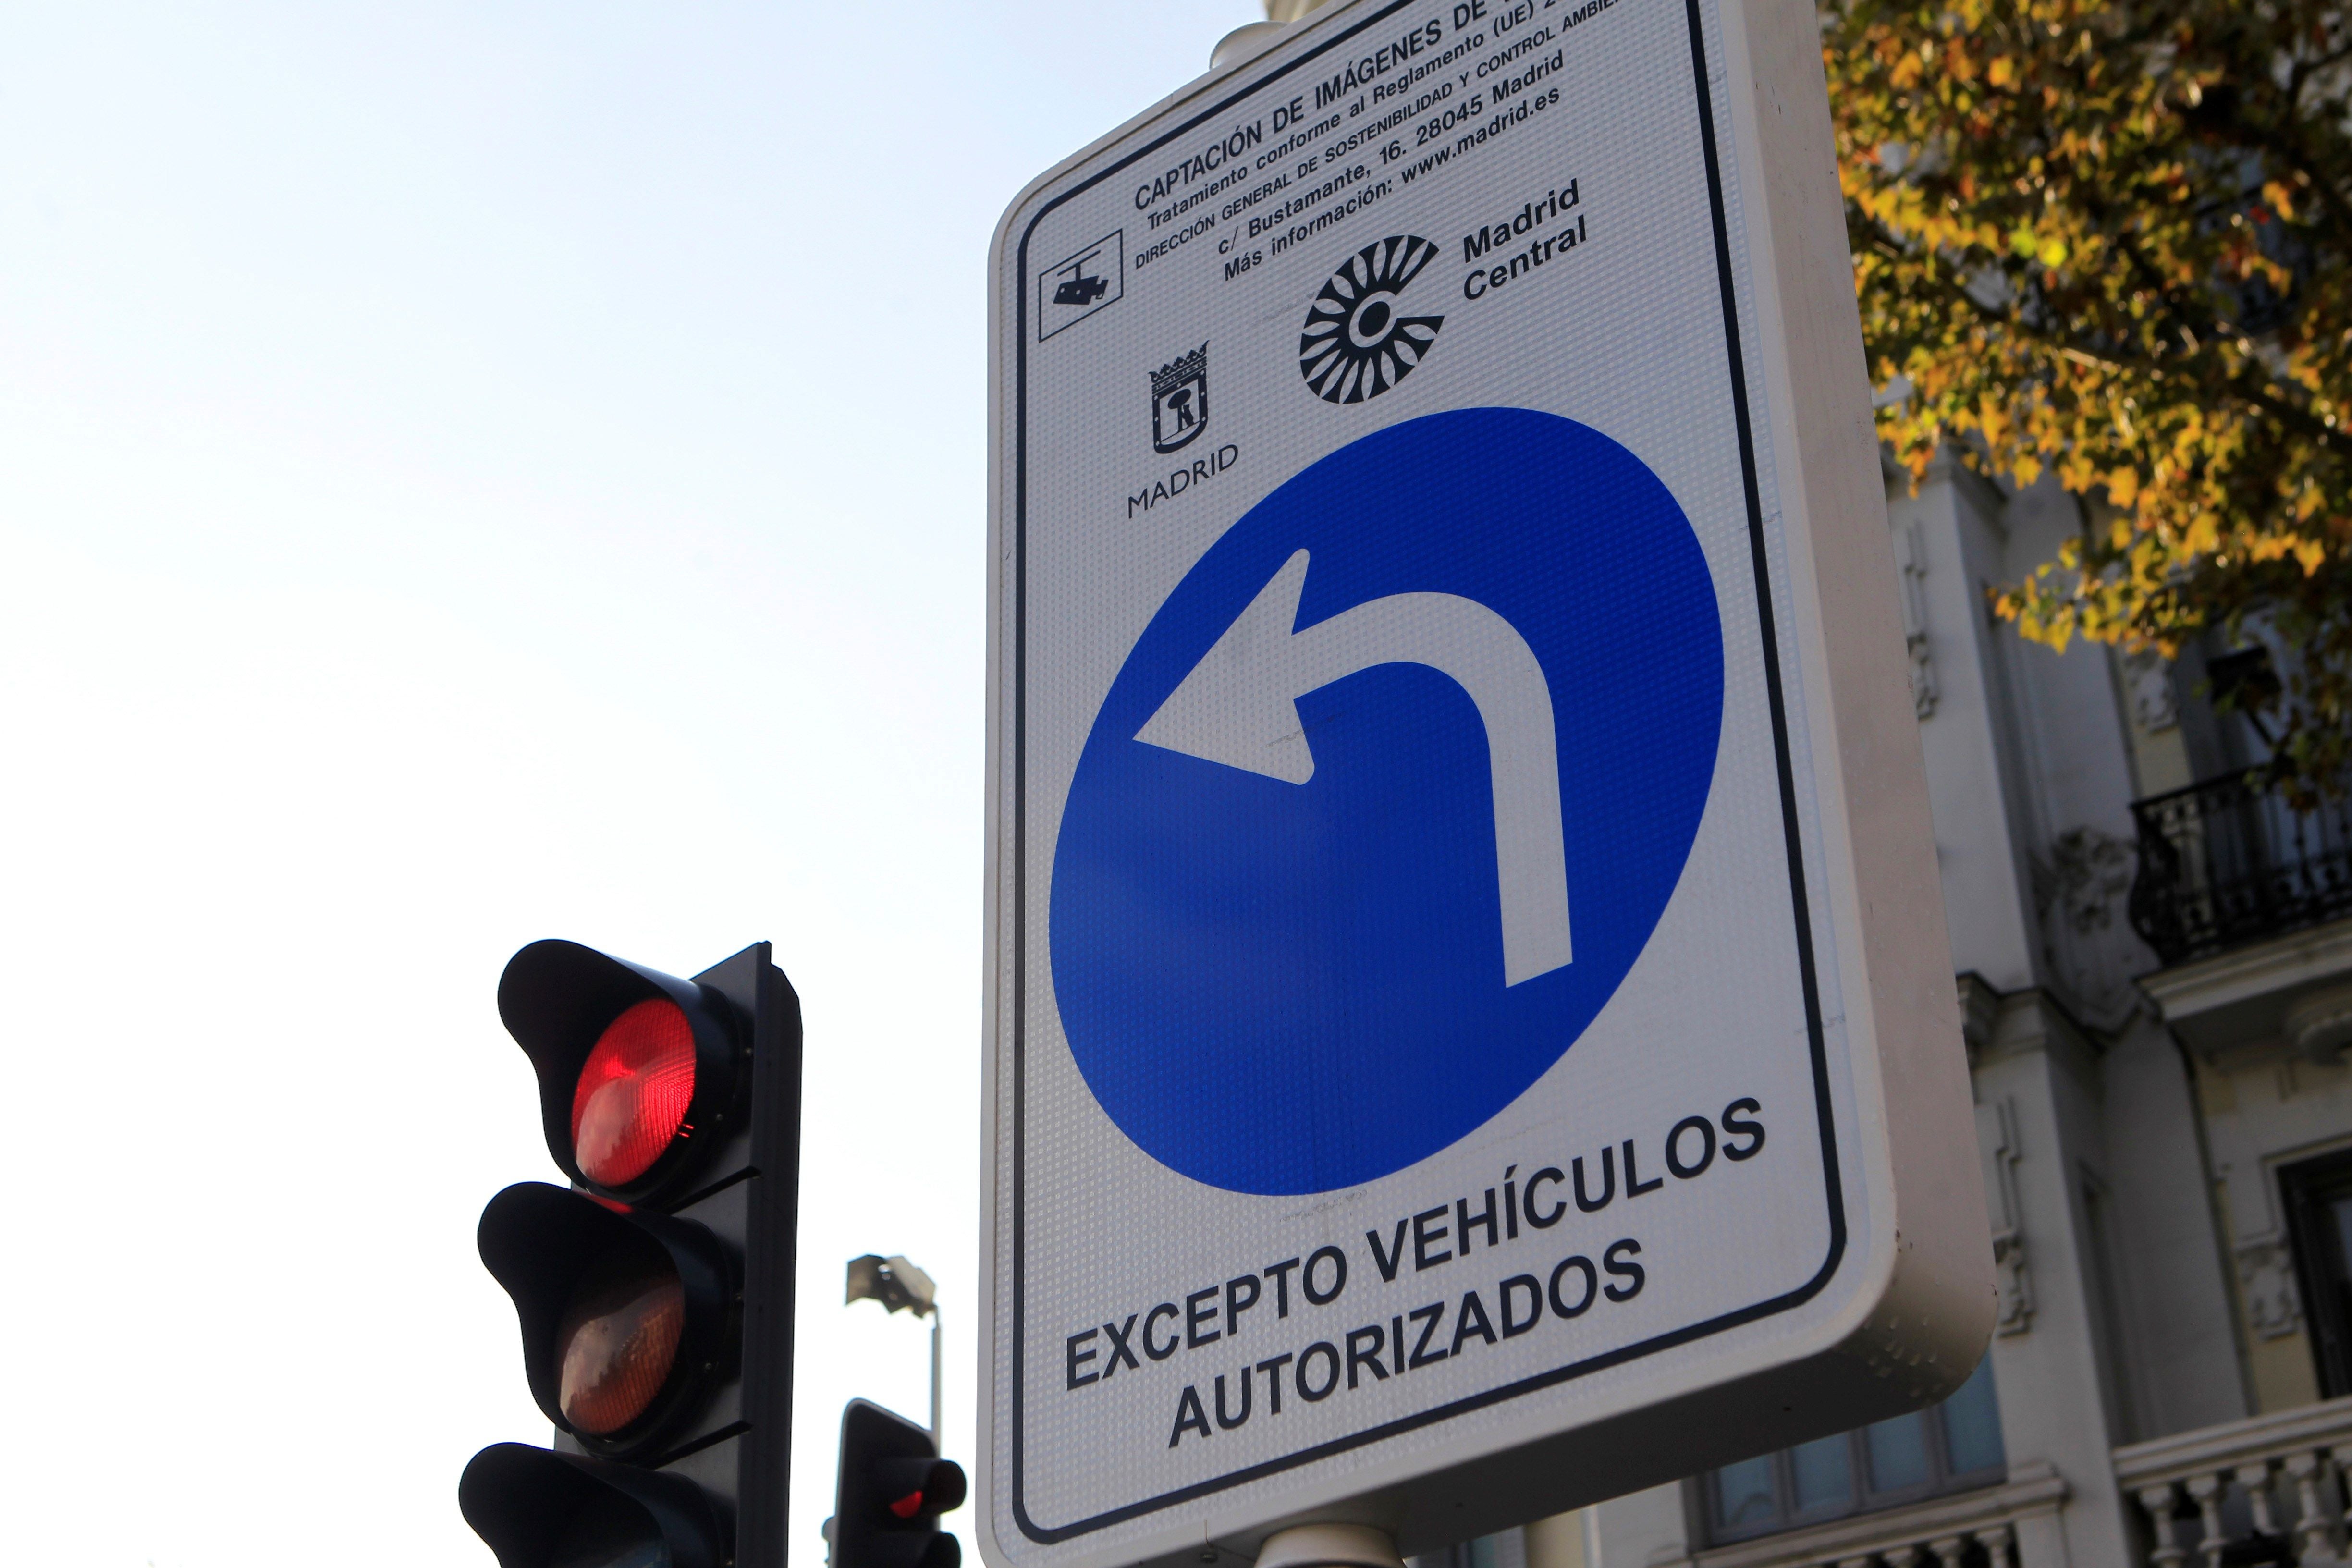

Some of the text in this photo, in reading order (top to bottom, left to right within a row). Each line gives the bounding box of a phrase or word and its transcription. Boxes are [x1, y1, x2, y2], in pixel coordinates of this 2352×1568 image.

[1135, 0, 1487, 210] CAPTACIÓN DE IMÁGENES DE
[1136, 0, 1618, 270] DIRECCIÓN GENERAL DE SOSTENIBILIDAD Y CONTROL AMBIE
[1147, 0, 1534, 230] Tratamiento conforme al Reglamento (UE)
[1218, 49, 1563, 255] c/ Bustamante, 16. 28045 Madrid
[1225, 88, 1560, 282] Más información: www.madrid.es
[1463, 177, 1579, 264] Madrid
[1463, 214, 1587, 301] Central
[1128, 444, 1239, 519] MADRID
[1067, 1097, 1766, 1391] EXCEPTO VEHÍCULOS
[1168, 1238, 1645, 1449] AUTORIZADOS
